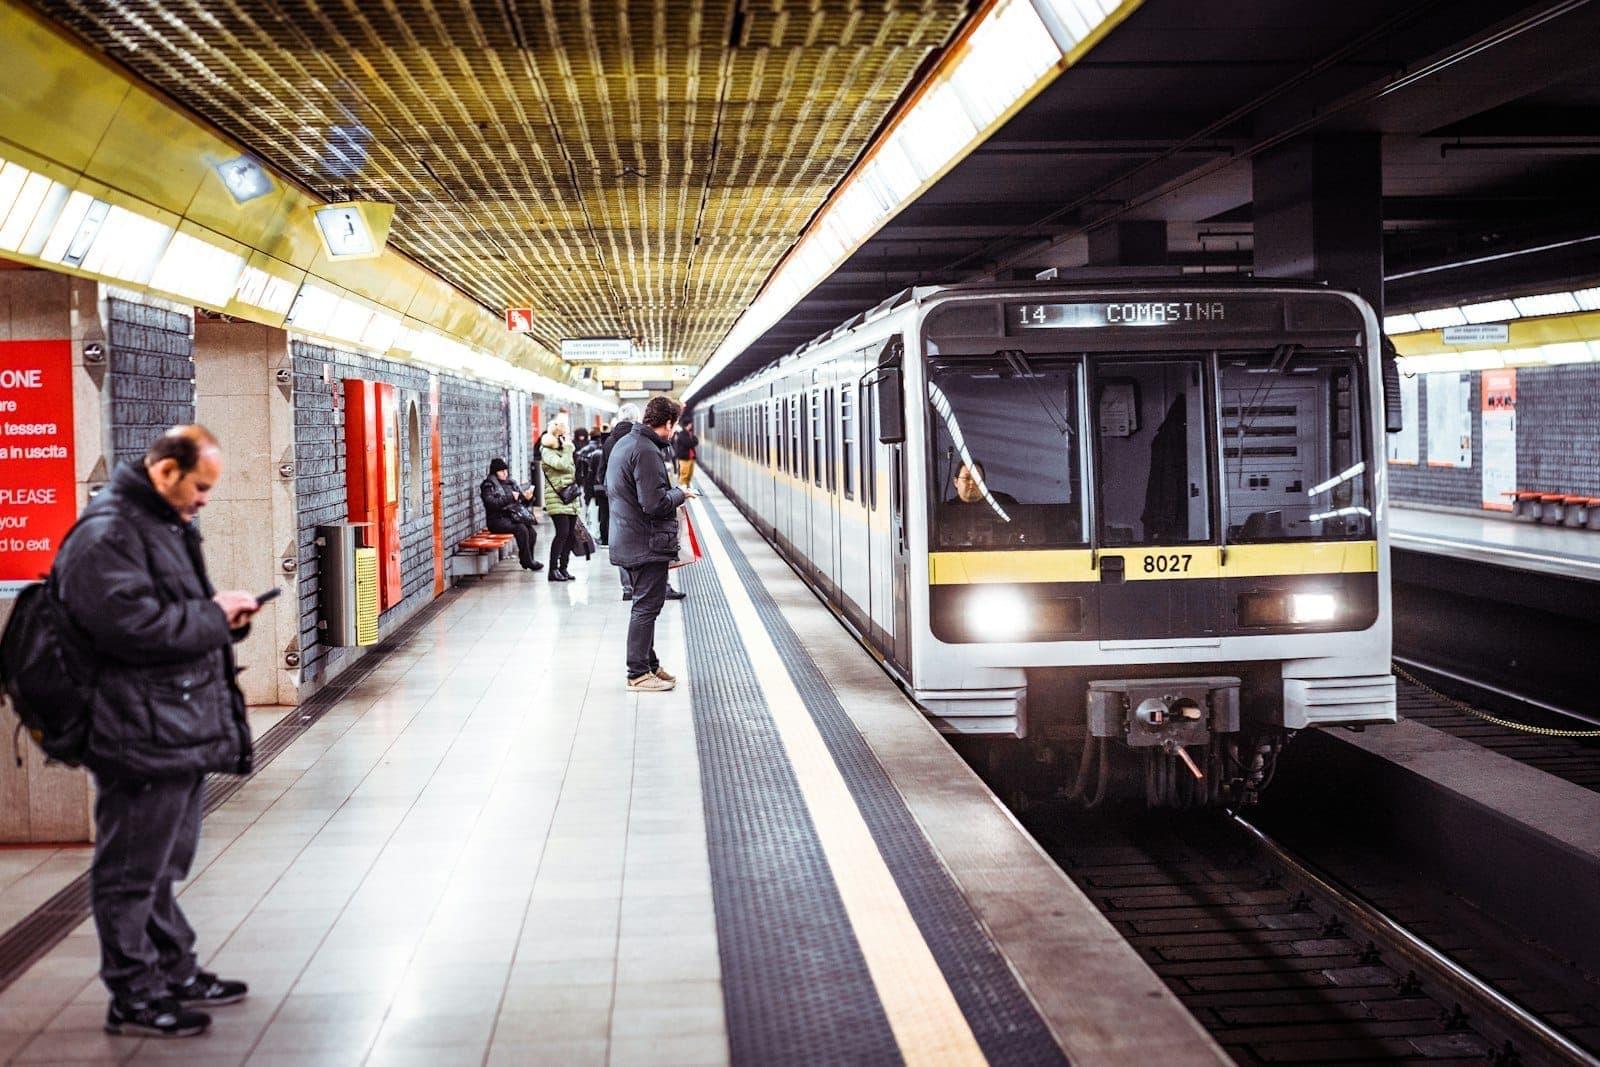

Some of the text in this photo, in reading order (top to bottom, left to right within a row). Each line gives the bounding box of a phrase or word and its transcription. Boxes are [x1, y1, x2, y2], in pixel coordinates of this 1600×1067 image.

[1019, 302, 1226, 324] 14 COMASINA
[0, 369, 43, 389] ONE
[4, 421, 57, 436] tessera
[10, 445, 23, 459] in
[24, 444, 68, 459] uscita
[0, 488, 57, 505] PLEASE
[10, 538, 24, 552] to
[26, 537, 50, 551] exit
[1143, 555, 1193, 573] 8027
